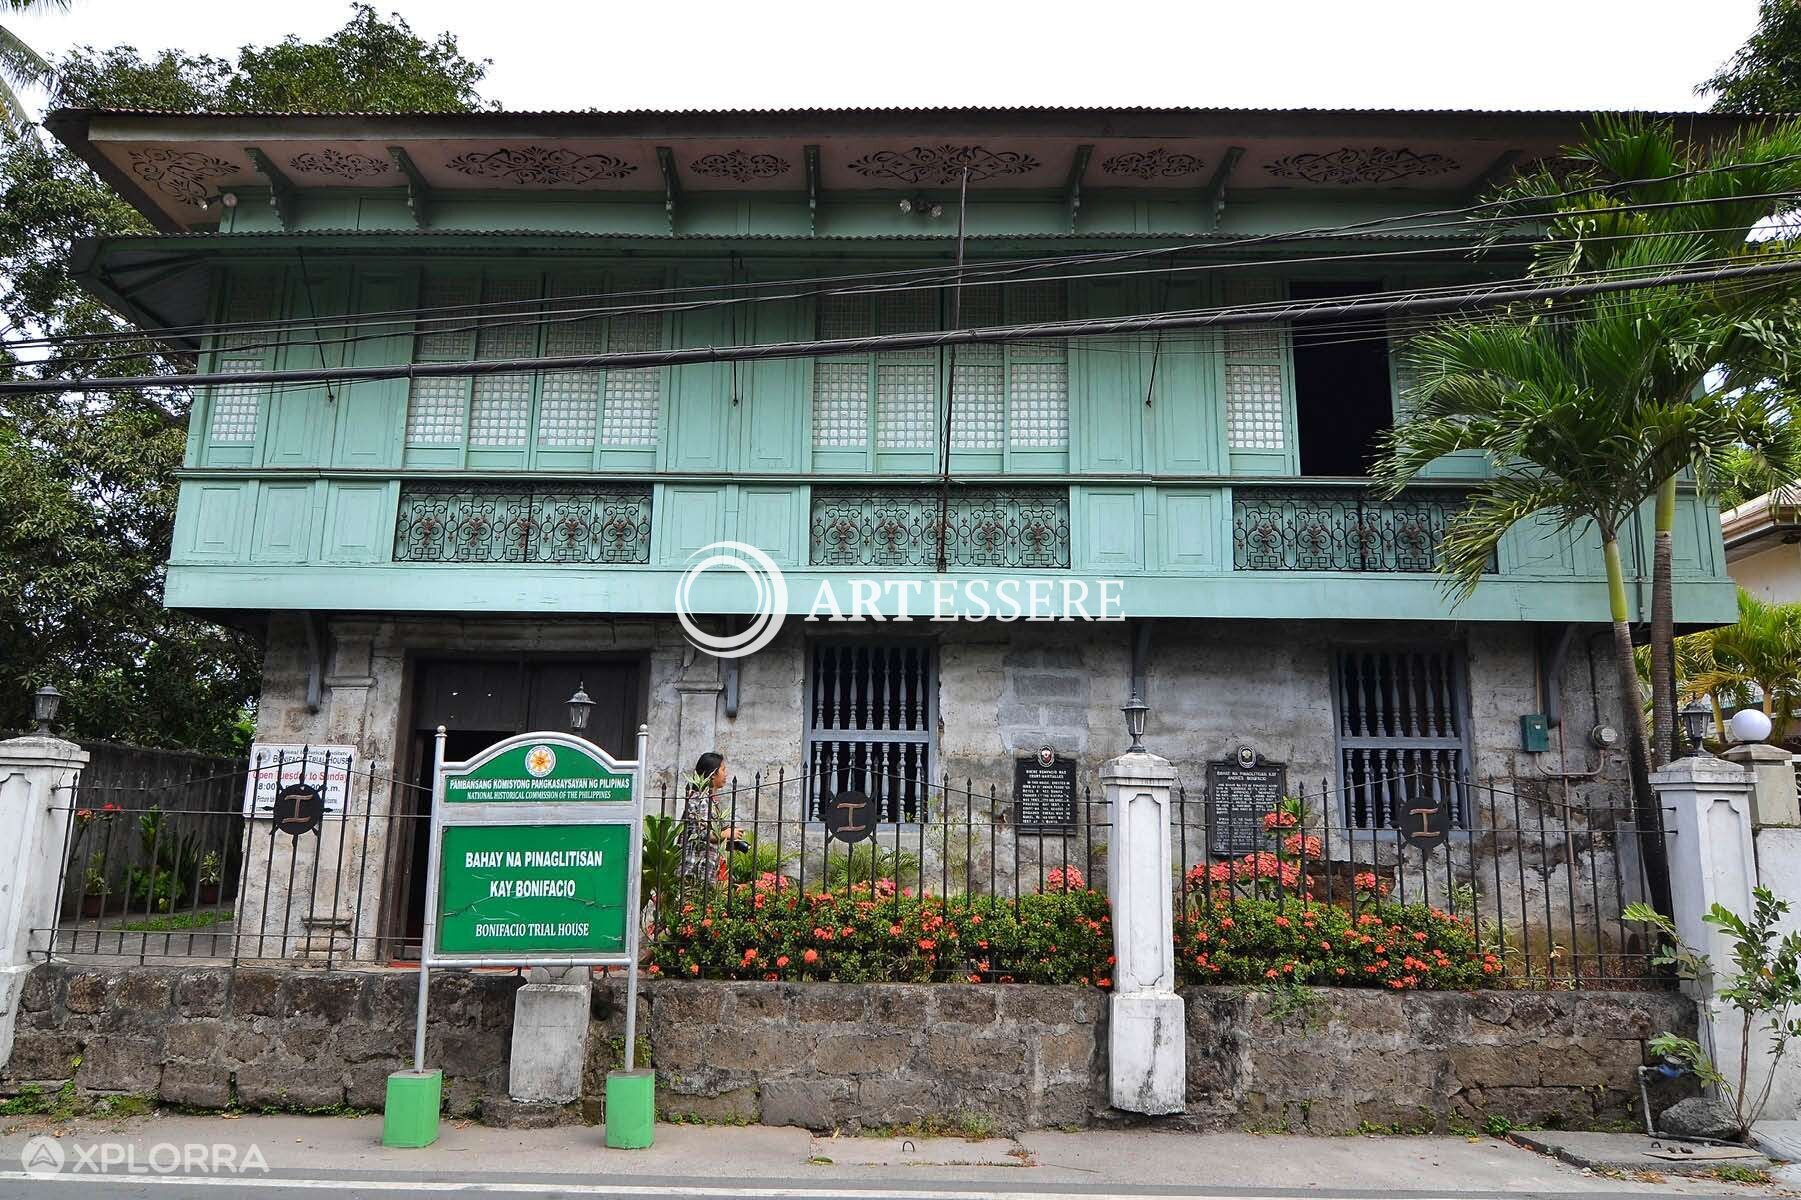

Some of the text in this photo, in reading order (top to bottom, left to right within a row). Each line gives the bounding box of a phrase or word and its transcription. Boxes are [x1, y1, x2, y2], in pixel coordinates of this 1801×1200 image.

[450, 778, 630, 789] PAMBANSANG KOMISYONG PANGKASAYSAYAN NG PILIPINAS
[467, 791, 612, 799] NATIONAL HISTORICAL COMMISSION OF THE PHILIPPINES
[465, 851, 602, 867] BAHAY NA PINAGLITISAN
[490, 880, 576, 897] KAY BONIFACIO
[475, 923, 590, 937] BONIFACIO TRIAL HOUSE
